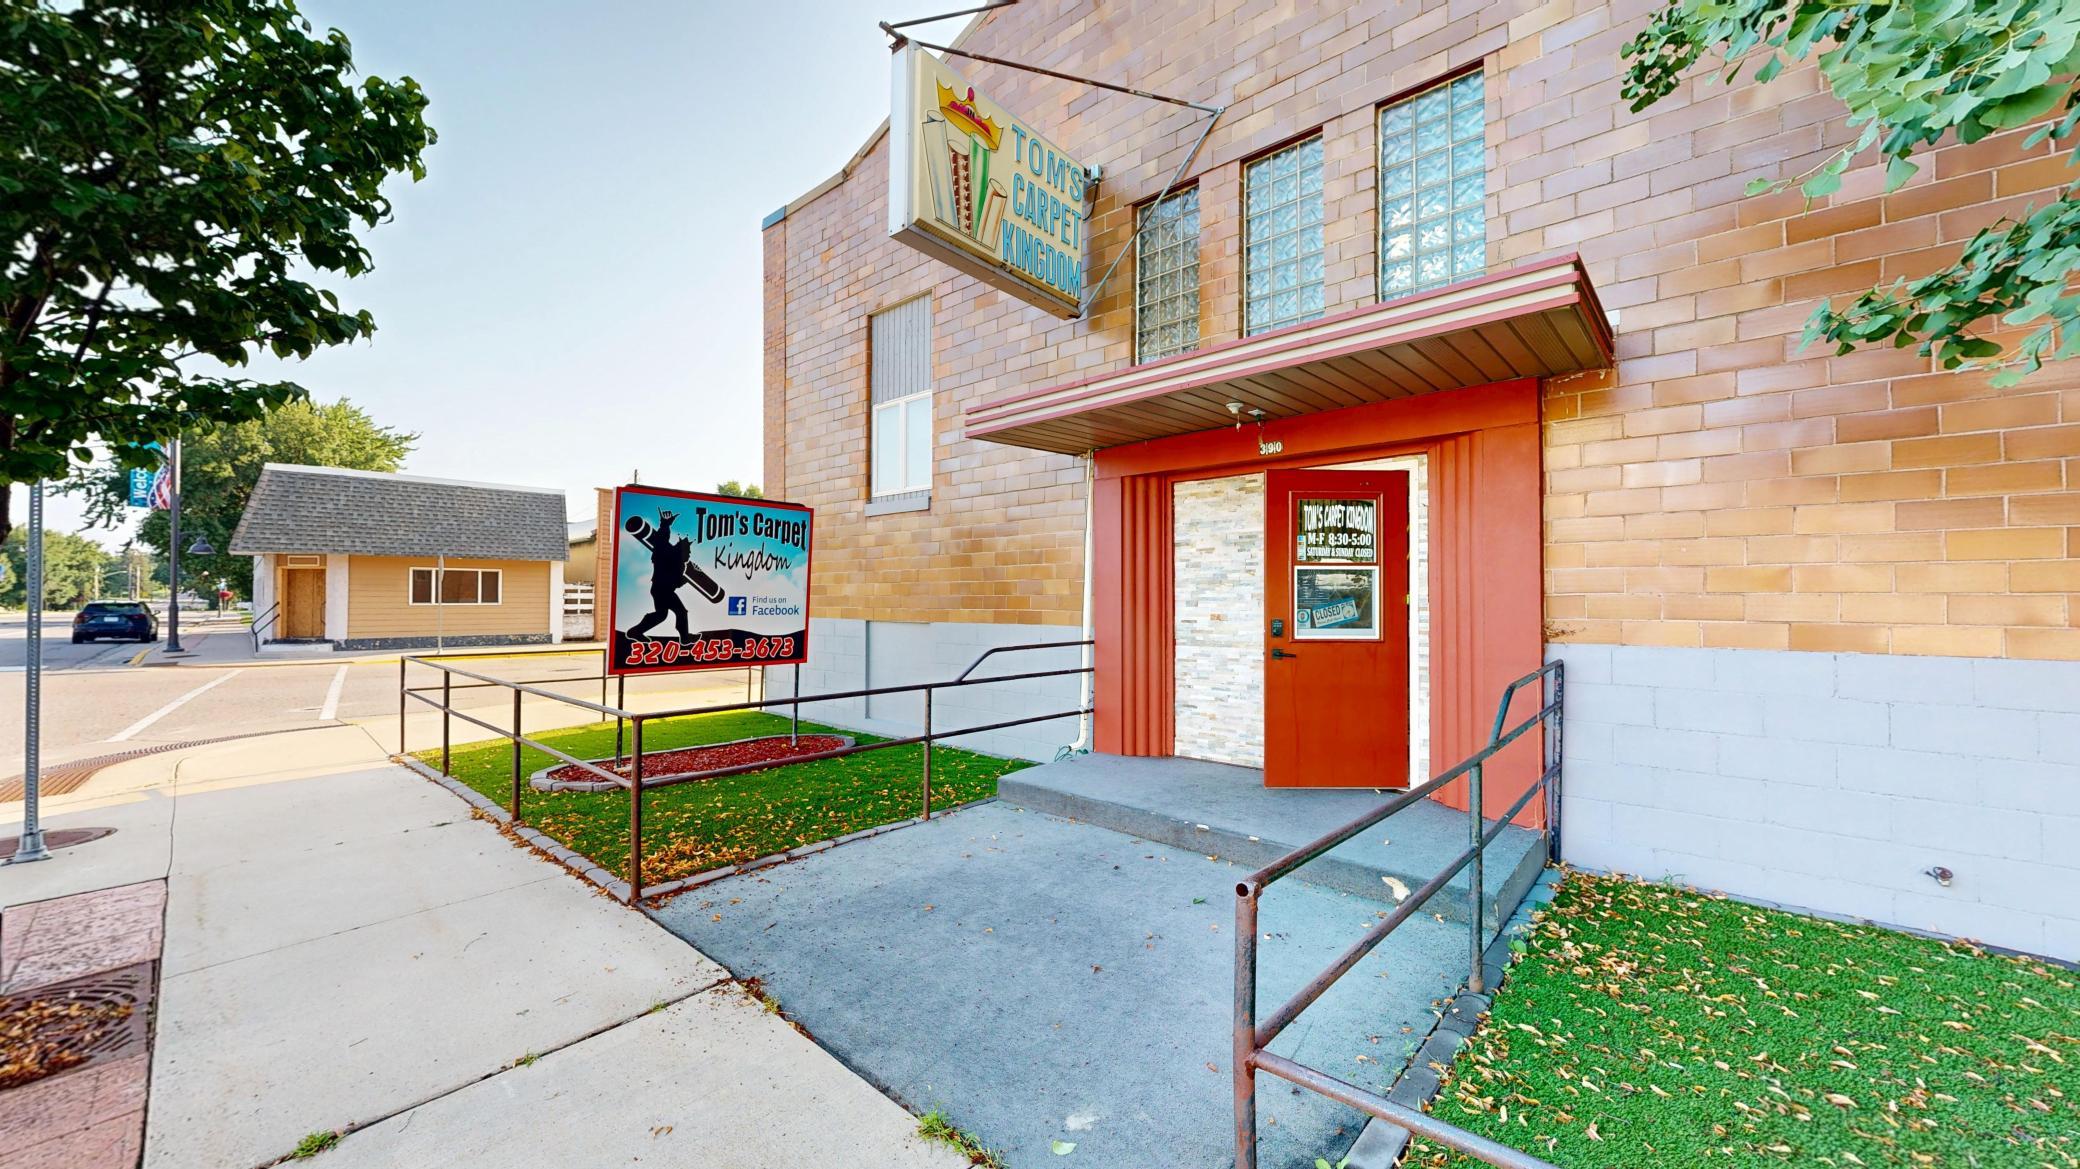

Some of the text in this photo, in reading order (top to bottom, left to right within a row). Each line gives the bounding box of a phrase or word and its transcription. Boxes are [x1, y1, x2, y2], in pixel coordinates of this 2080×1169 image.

[1011, 123, 1083, 202] TOM'S
[1012, 172, 1082, 250] CARPET
[1002, 218, 1082, 299] KINGDOM
[1260, 441, 1282, 455] 390
[695, 507, 807, 552] Tom's Carpet
[1304, 504, 1374, 534] TOM'S CARPET KINGDOM
[1306, 547, 1331, 557] SATURDAY
[1336, 548, 1354, 557] SUNDAY
[1355, 548, 1373, 558] CLOSED
[1307, 532, 1372, 546] M-F 8:30-5:00
[714, 541, 792, 581] Kingdom
[752, 596, 768, 604] Find
[752, 605, 800, 616] Facebook
[1315, 605, 1341, 621] CLOSED
[626, 637, 795, 665] 320-453-3673
